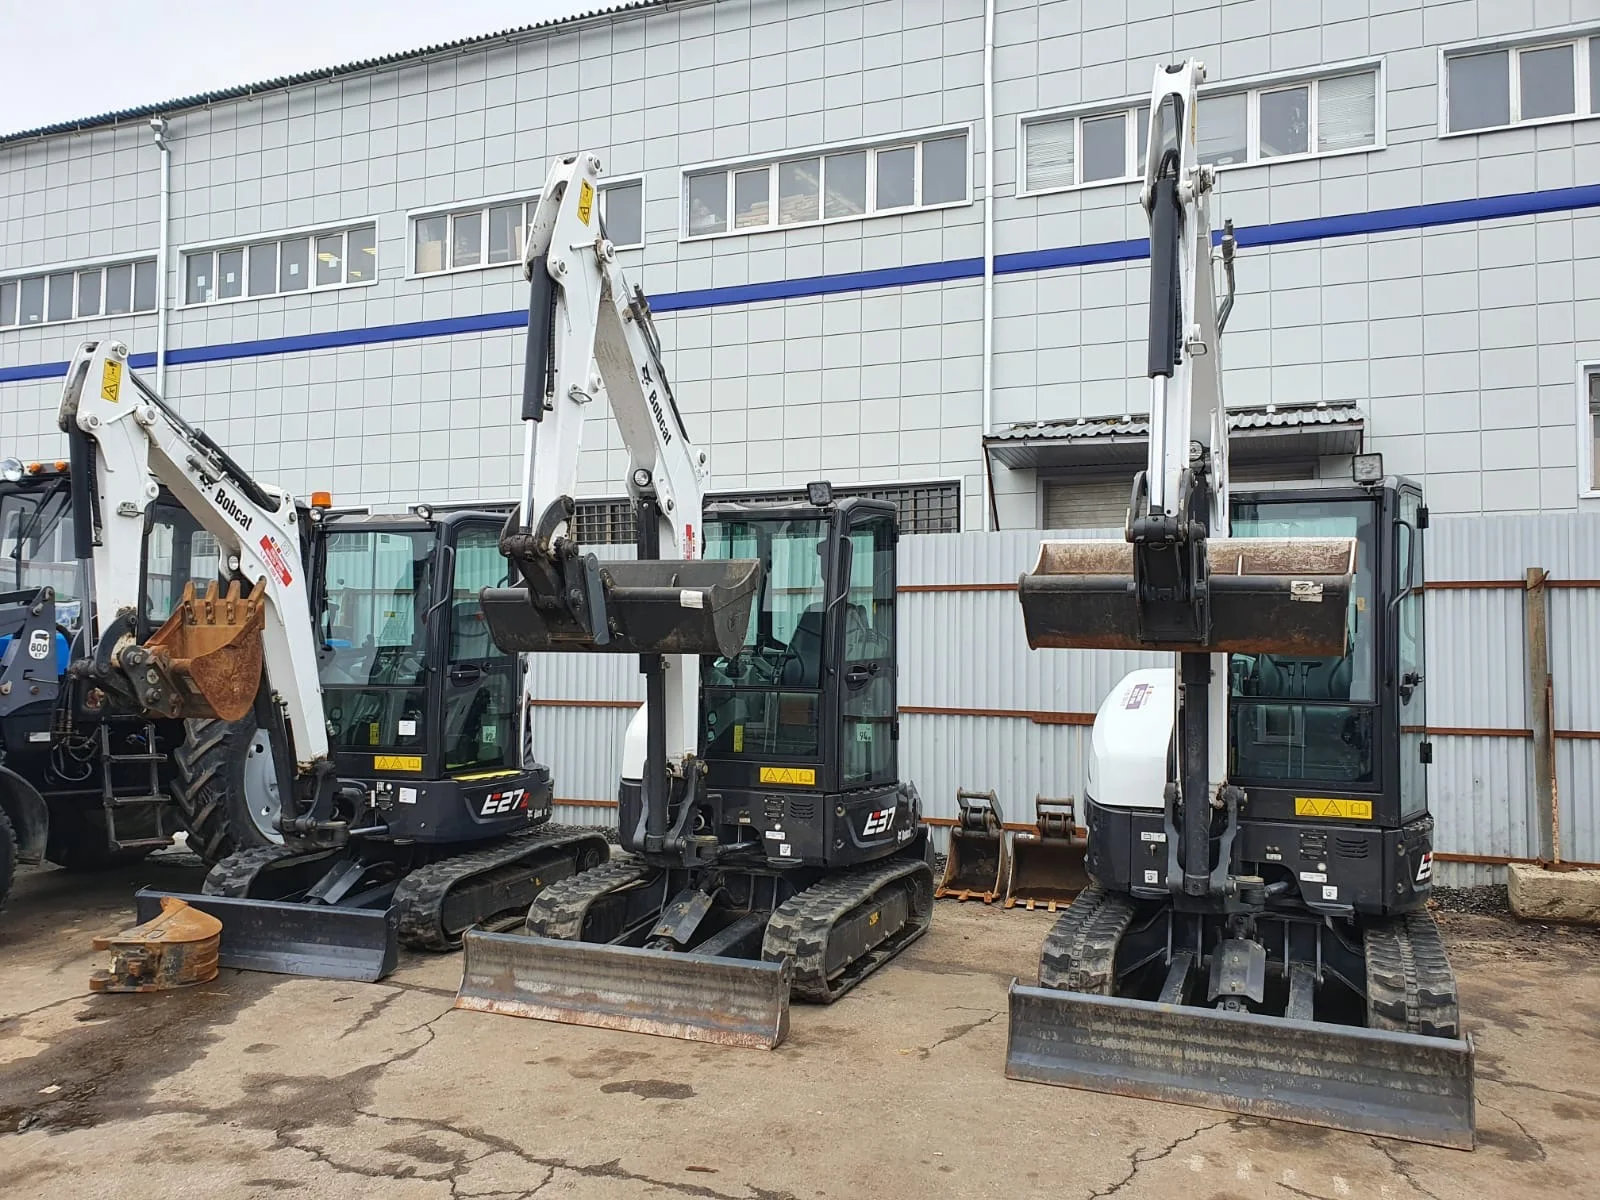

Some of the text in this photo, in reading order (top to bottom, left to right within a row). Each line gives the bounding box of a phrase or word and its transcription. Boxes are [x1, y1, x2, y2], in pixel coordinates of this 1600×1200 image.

[649, 389, 671, 446] Bobcat
[215, 487, 252, 531] Bobcat
[31, 642, 48, 653] 800
[862, 806, 896, 836] E37
